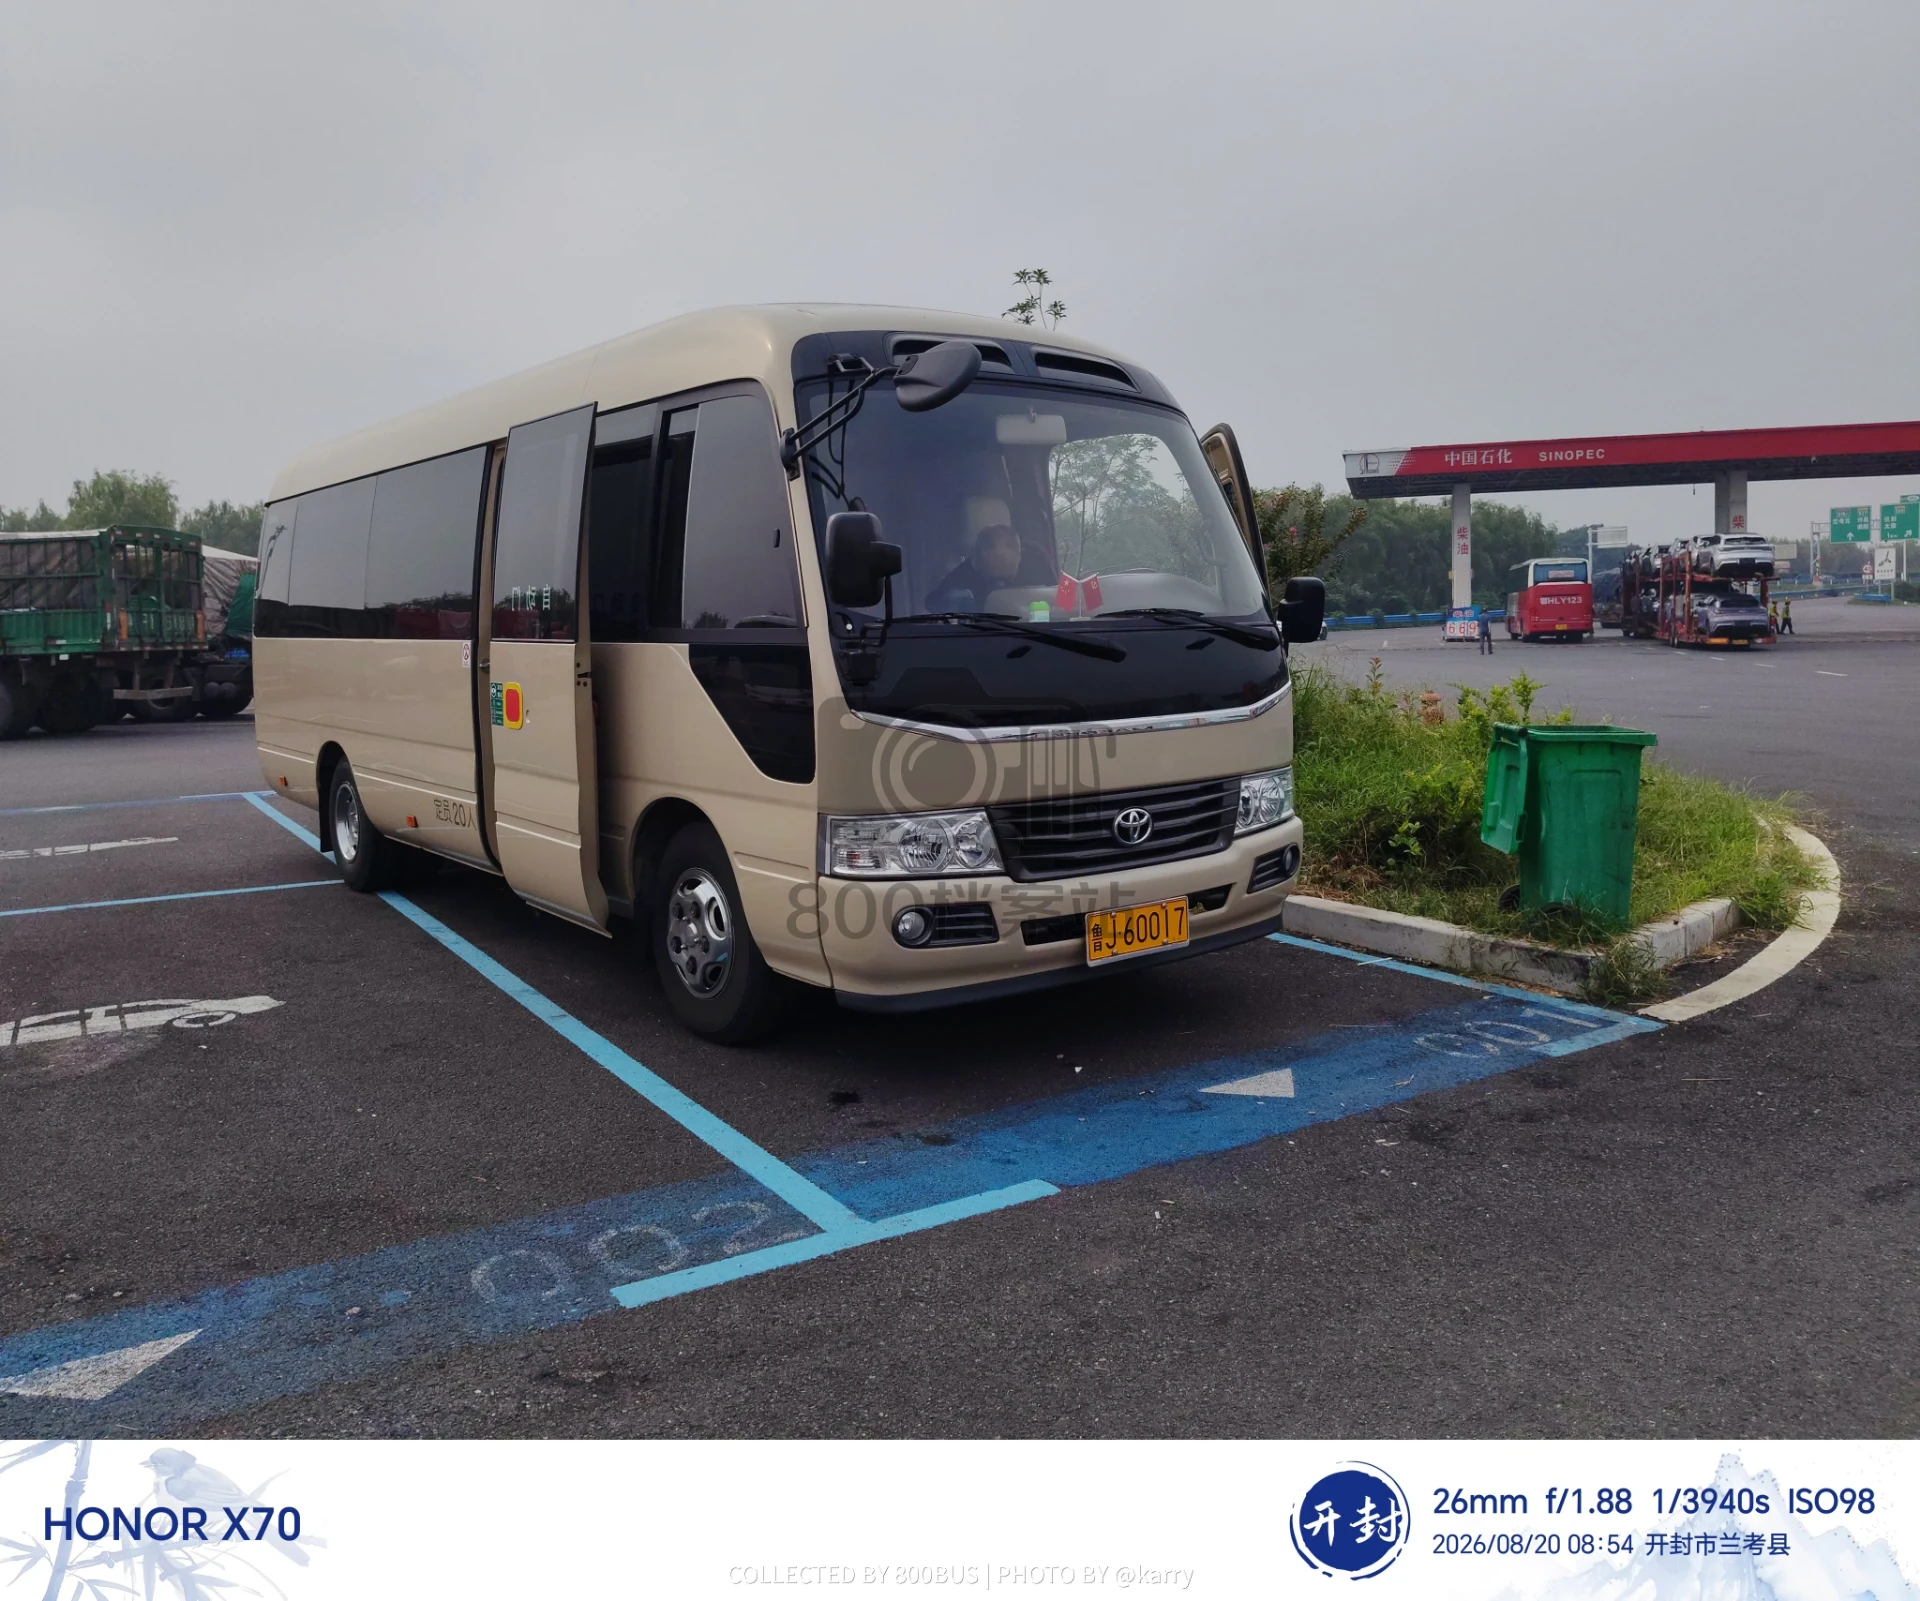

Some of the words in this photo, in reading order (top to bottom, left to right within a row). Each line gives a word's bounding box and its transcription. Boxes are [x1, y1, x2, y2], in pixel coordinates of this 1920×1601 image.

[1444, 448, 1513, 467] 中国石化
[1538, 449, 1606, 462] SINOPEC
[1457, 526, 1469, 556] 柴油
[1547, 596, 1583, 605] HLY123
[433, 798, 478, 832] 定员20人
